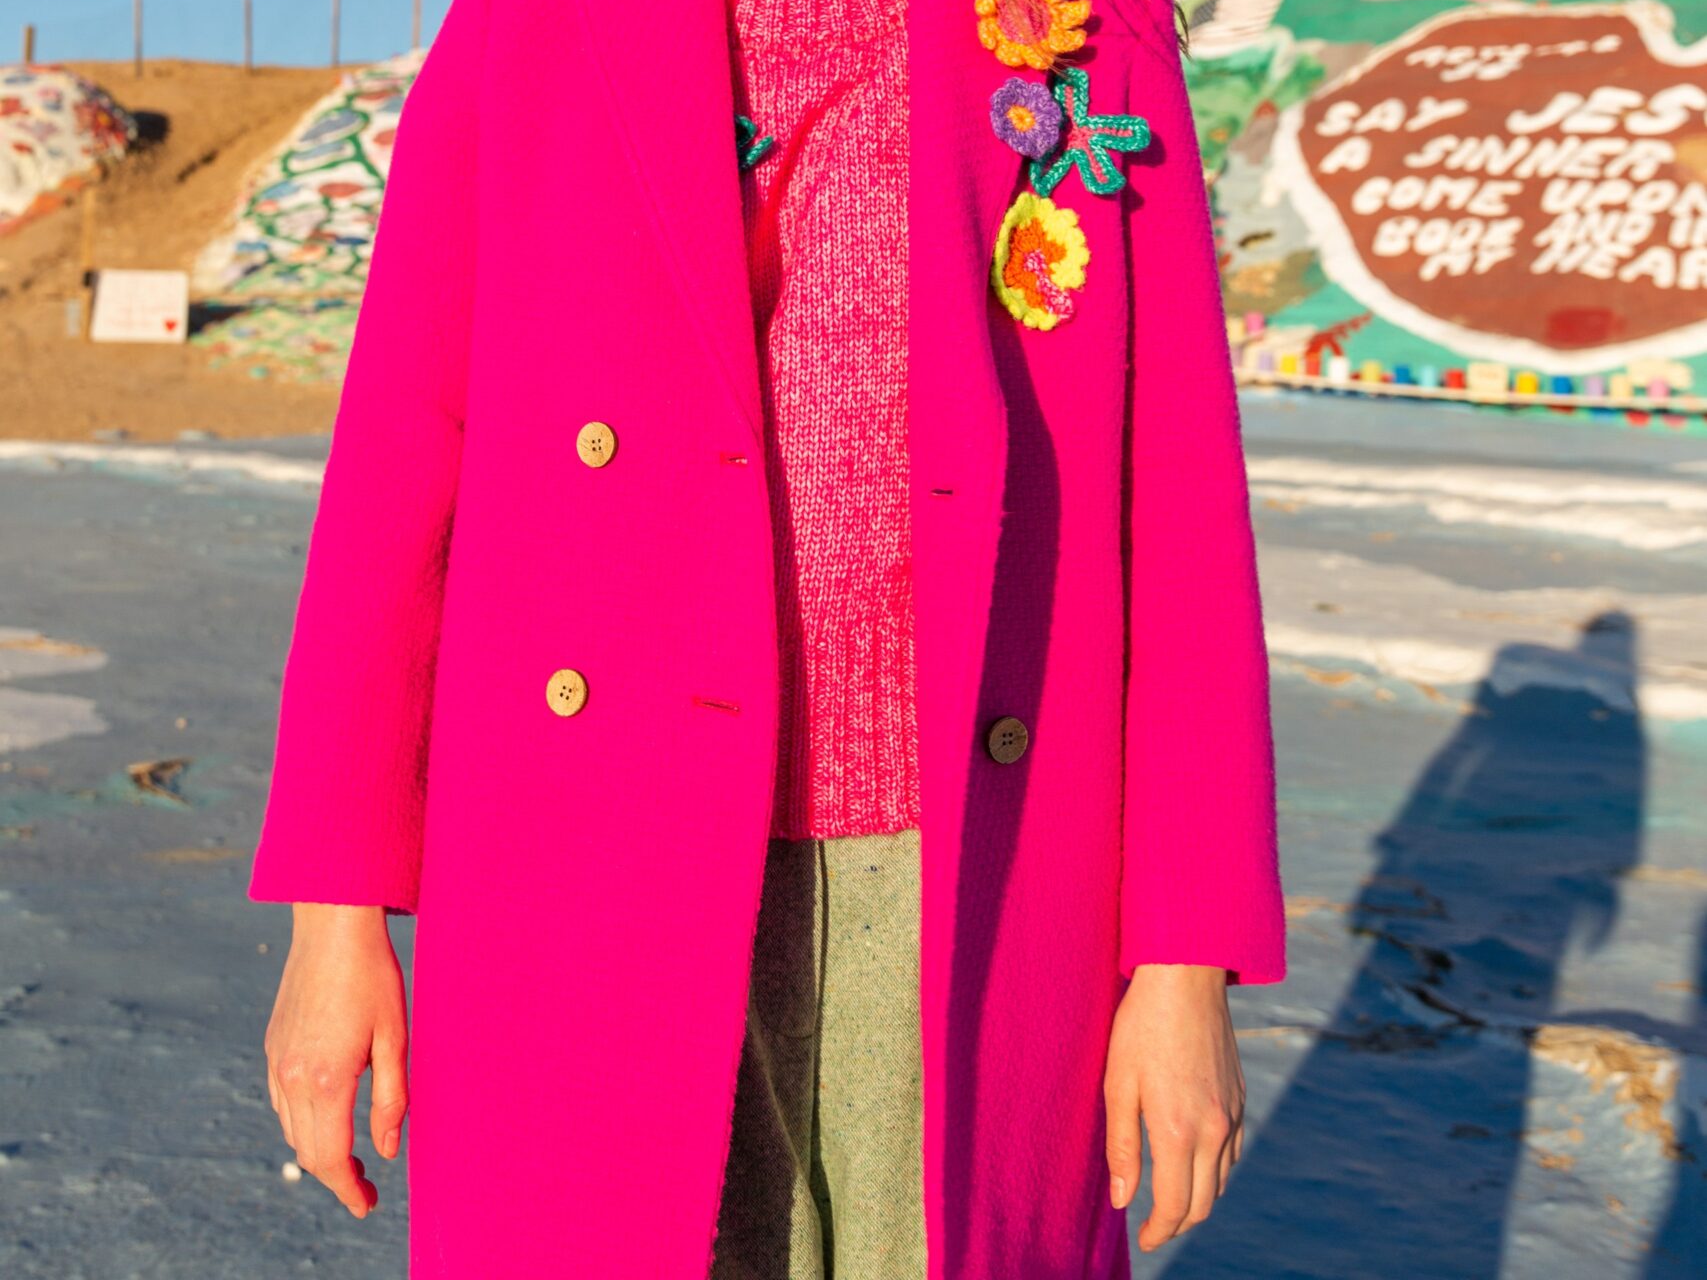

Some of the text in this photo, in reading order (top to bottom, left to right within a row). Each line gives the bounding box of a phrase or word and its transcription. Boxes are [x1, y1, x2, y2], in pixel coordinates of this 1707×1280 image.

[1315, 83, 1707, 137] SAY JES
[1318, 134, 1676, 182] A SINNER
[1352, 175, 1524, 217] COME
[1532, 211, 1656, 248] AND
